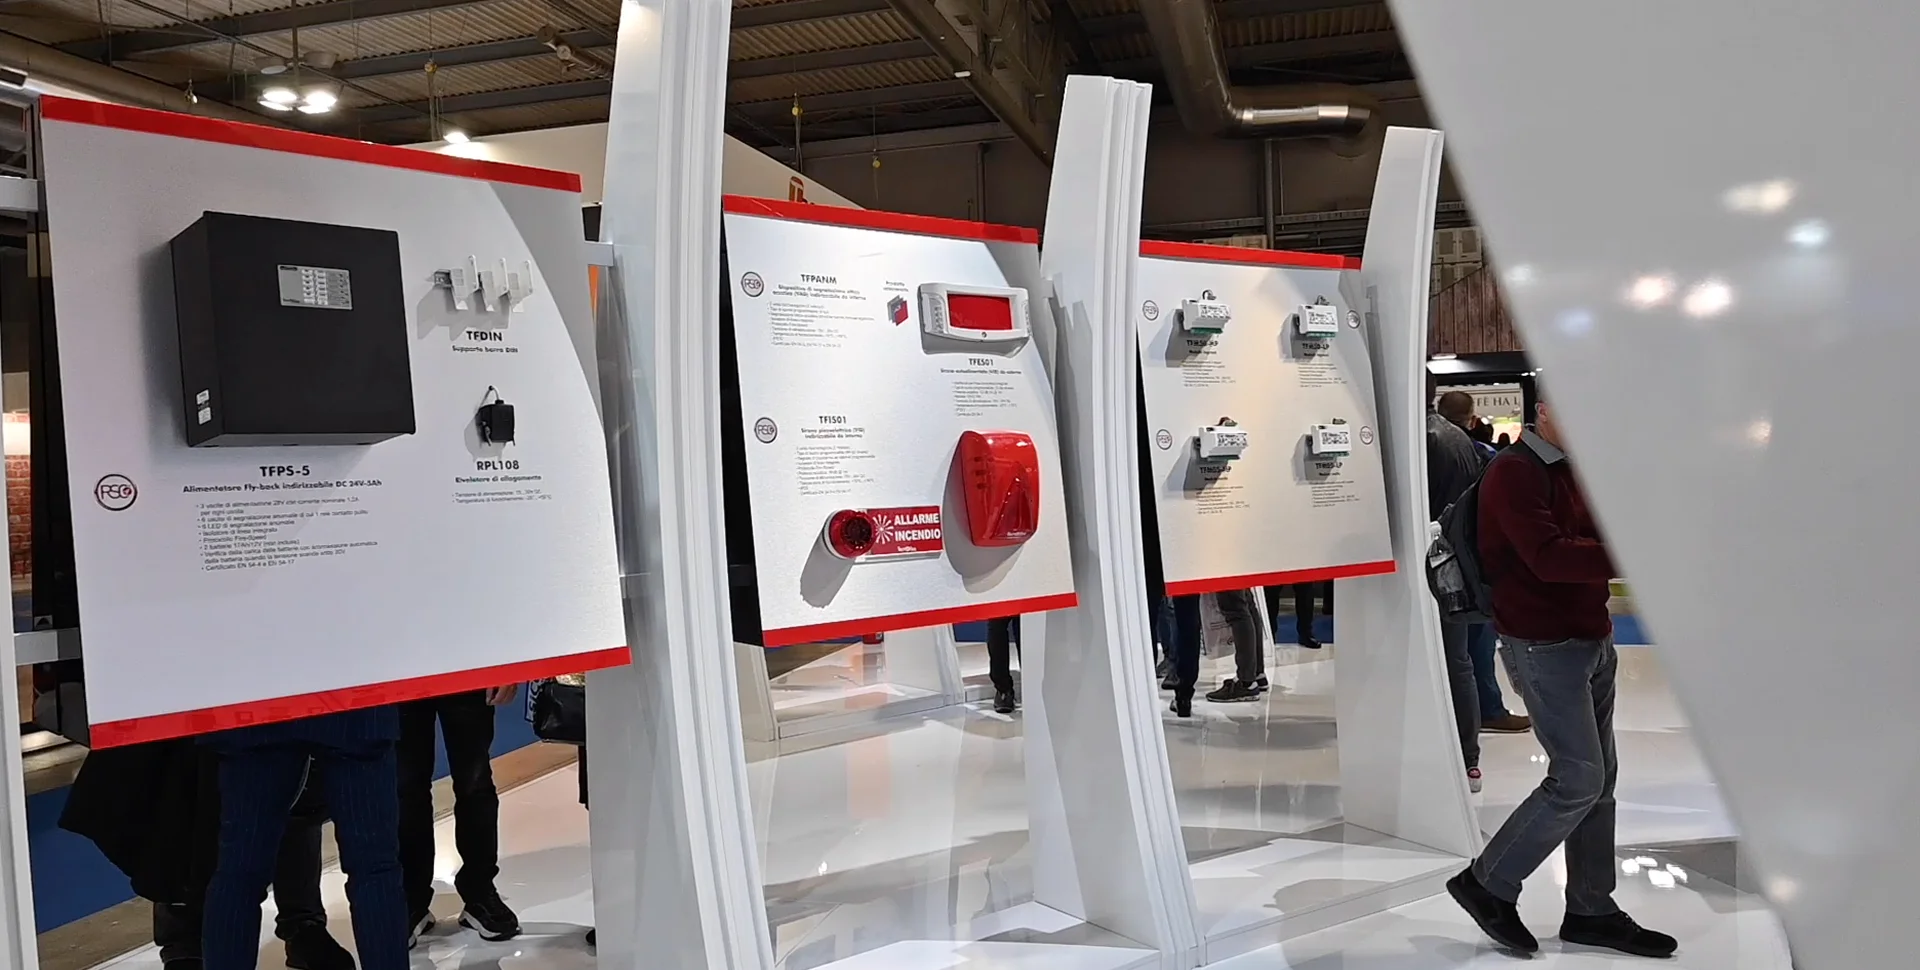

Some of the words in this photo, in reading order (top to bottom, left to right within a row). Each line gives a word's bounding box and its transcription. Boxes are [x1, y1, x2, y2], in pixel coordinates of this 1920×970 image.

[801, 274, 837, 284] TFPANM
[466, 331, 502, 341] TFDIN
[1493, 397, 1510, 406] HA
[477, 460, 519, 470] RPL108
[259, 465, 310, 477] TFPS-5
[244, 483, 280, 491] Fly-back
[283, 481, 333, 489] indirizzabile
[894, 513, 939, 526] ALLARME
[895, 528, 941, 541] INCENDIO
